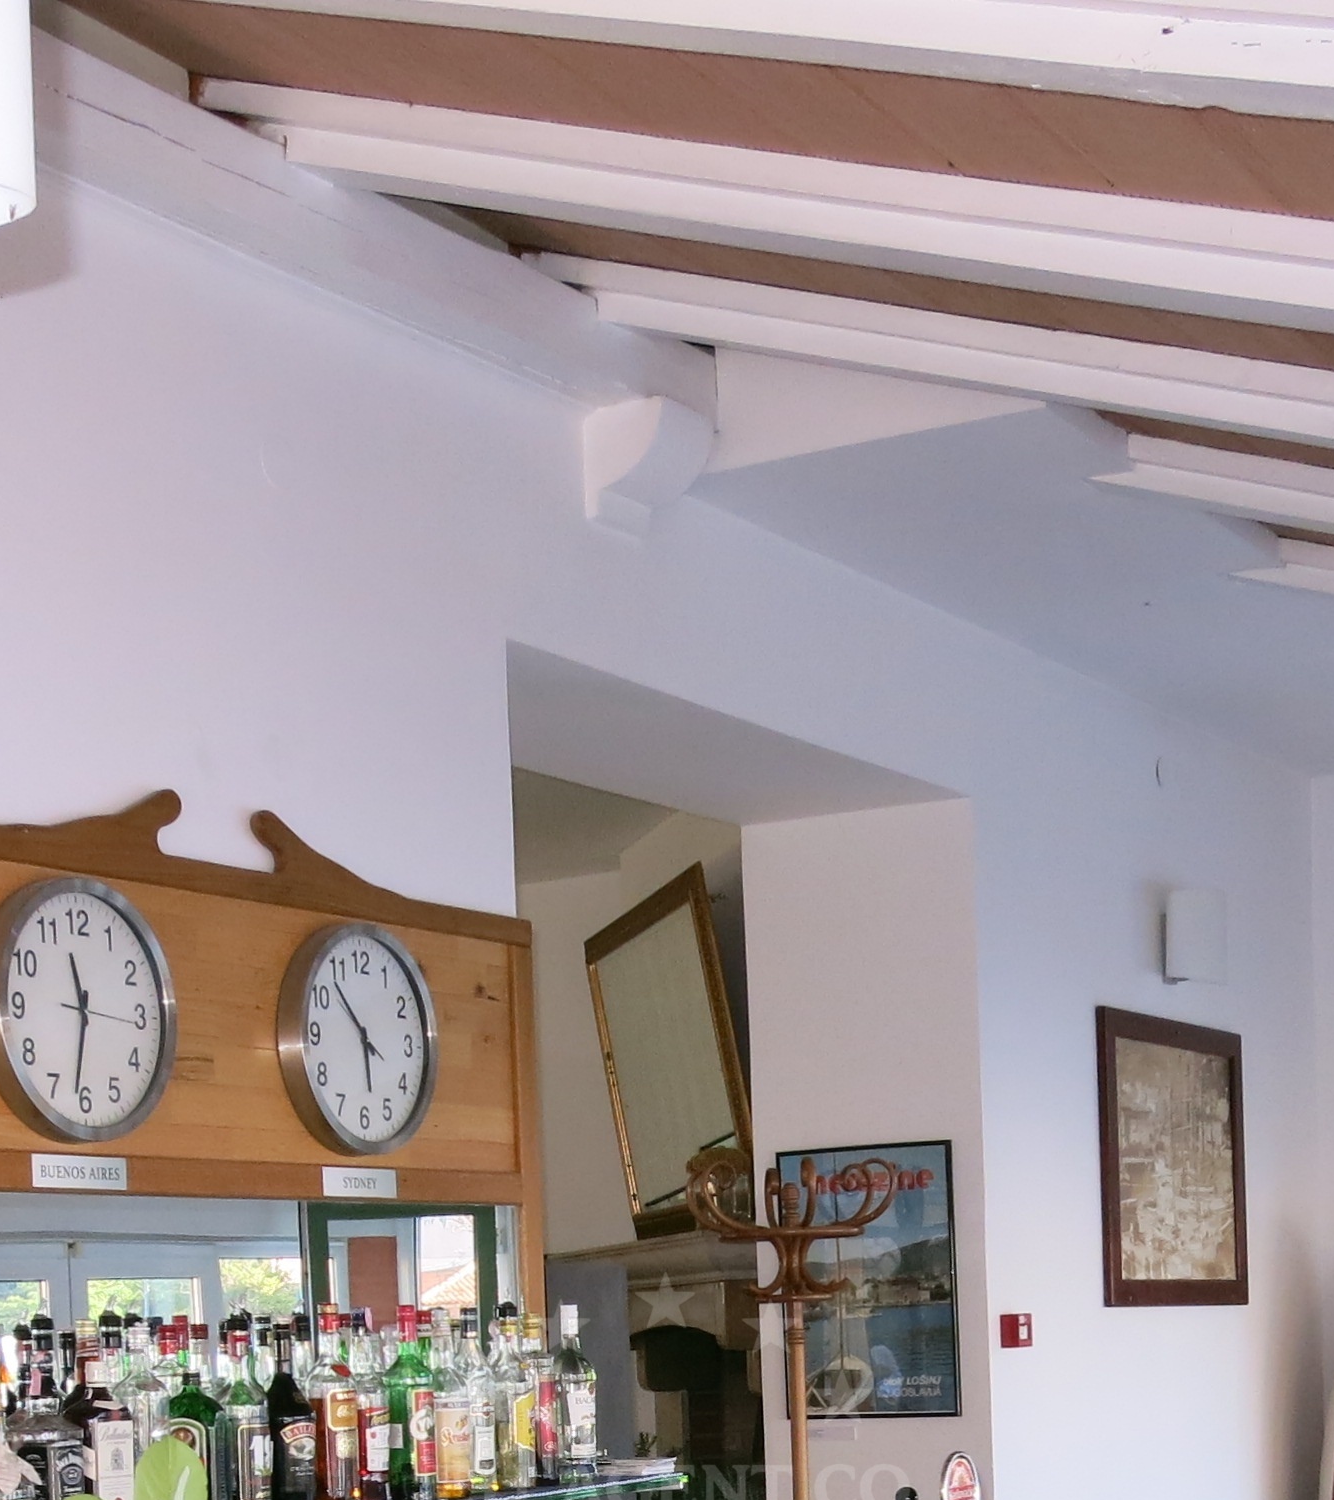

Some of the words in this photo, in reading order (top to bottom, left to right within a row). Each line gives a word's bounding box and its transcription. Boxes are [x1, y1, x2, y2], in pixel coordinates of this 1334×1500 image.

[37, 916, 58, 945] 11
[65, 909, 89, 937] 12
[104, 926, 113, 951] 1
[13, 949, 37, 977] 10
[125, 960, 136, 985] 2
[330, 956, 345, 981] 11
[351, 950, 370, 975] 12
[381, 966, 388, 988] 1
[12, 992, 25, 1019] 9
[312, 985, 329, 1009] 10
[397, 996, 406, 1019] 2
[134, 1004, 146, 1030] 3
[310, 1021, 320, 1045] 9
[23, 1038, 35, 1065] 8
[404, 1035, 413, 1057] 3
[128, 1047, 140, 1072] 4
[46, 1073, 59, 1099] 7
[317, 1062, 327, 1086] 8
[398, 1073, 407, 1095] 4
[79, 1086, 92, 1113] 6
[109, 1078, 120, 1103] 5
[336, 1094, 346, 1116] 7
[360, 1106, 370, 1129] 6
[382, 1098, 392, 1121] 5
[40, 1165, 86, 1180] BUENOS
[89, 1166, 120, 1181] AIRES
[343, 1176, 377, 1189] SYDNEY
[815, 1168, 934, 1195] nezne
[906, 1374, 942, 1385] LOŠINJ
